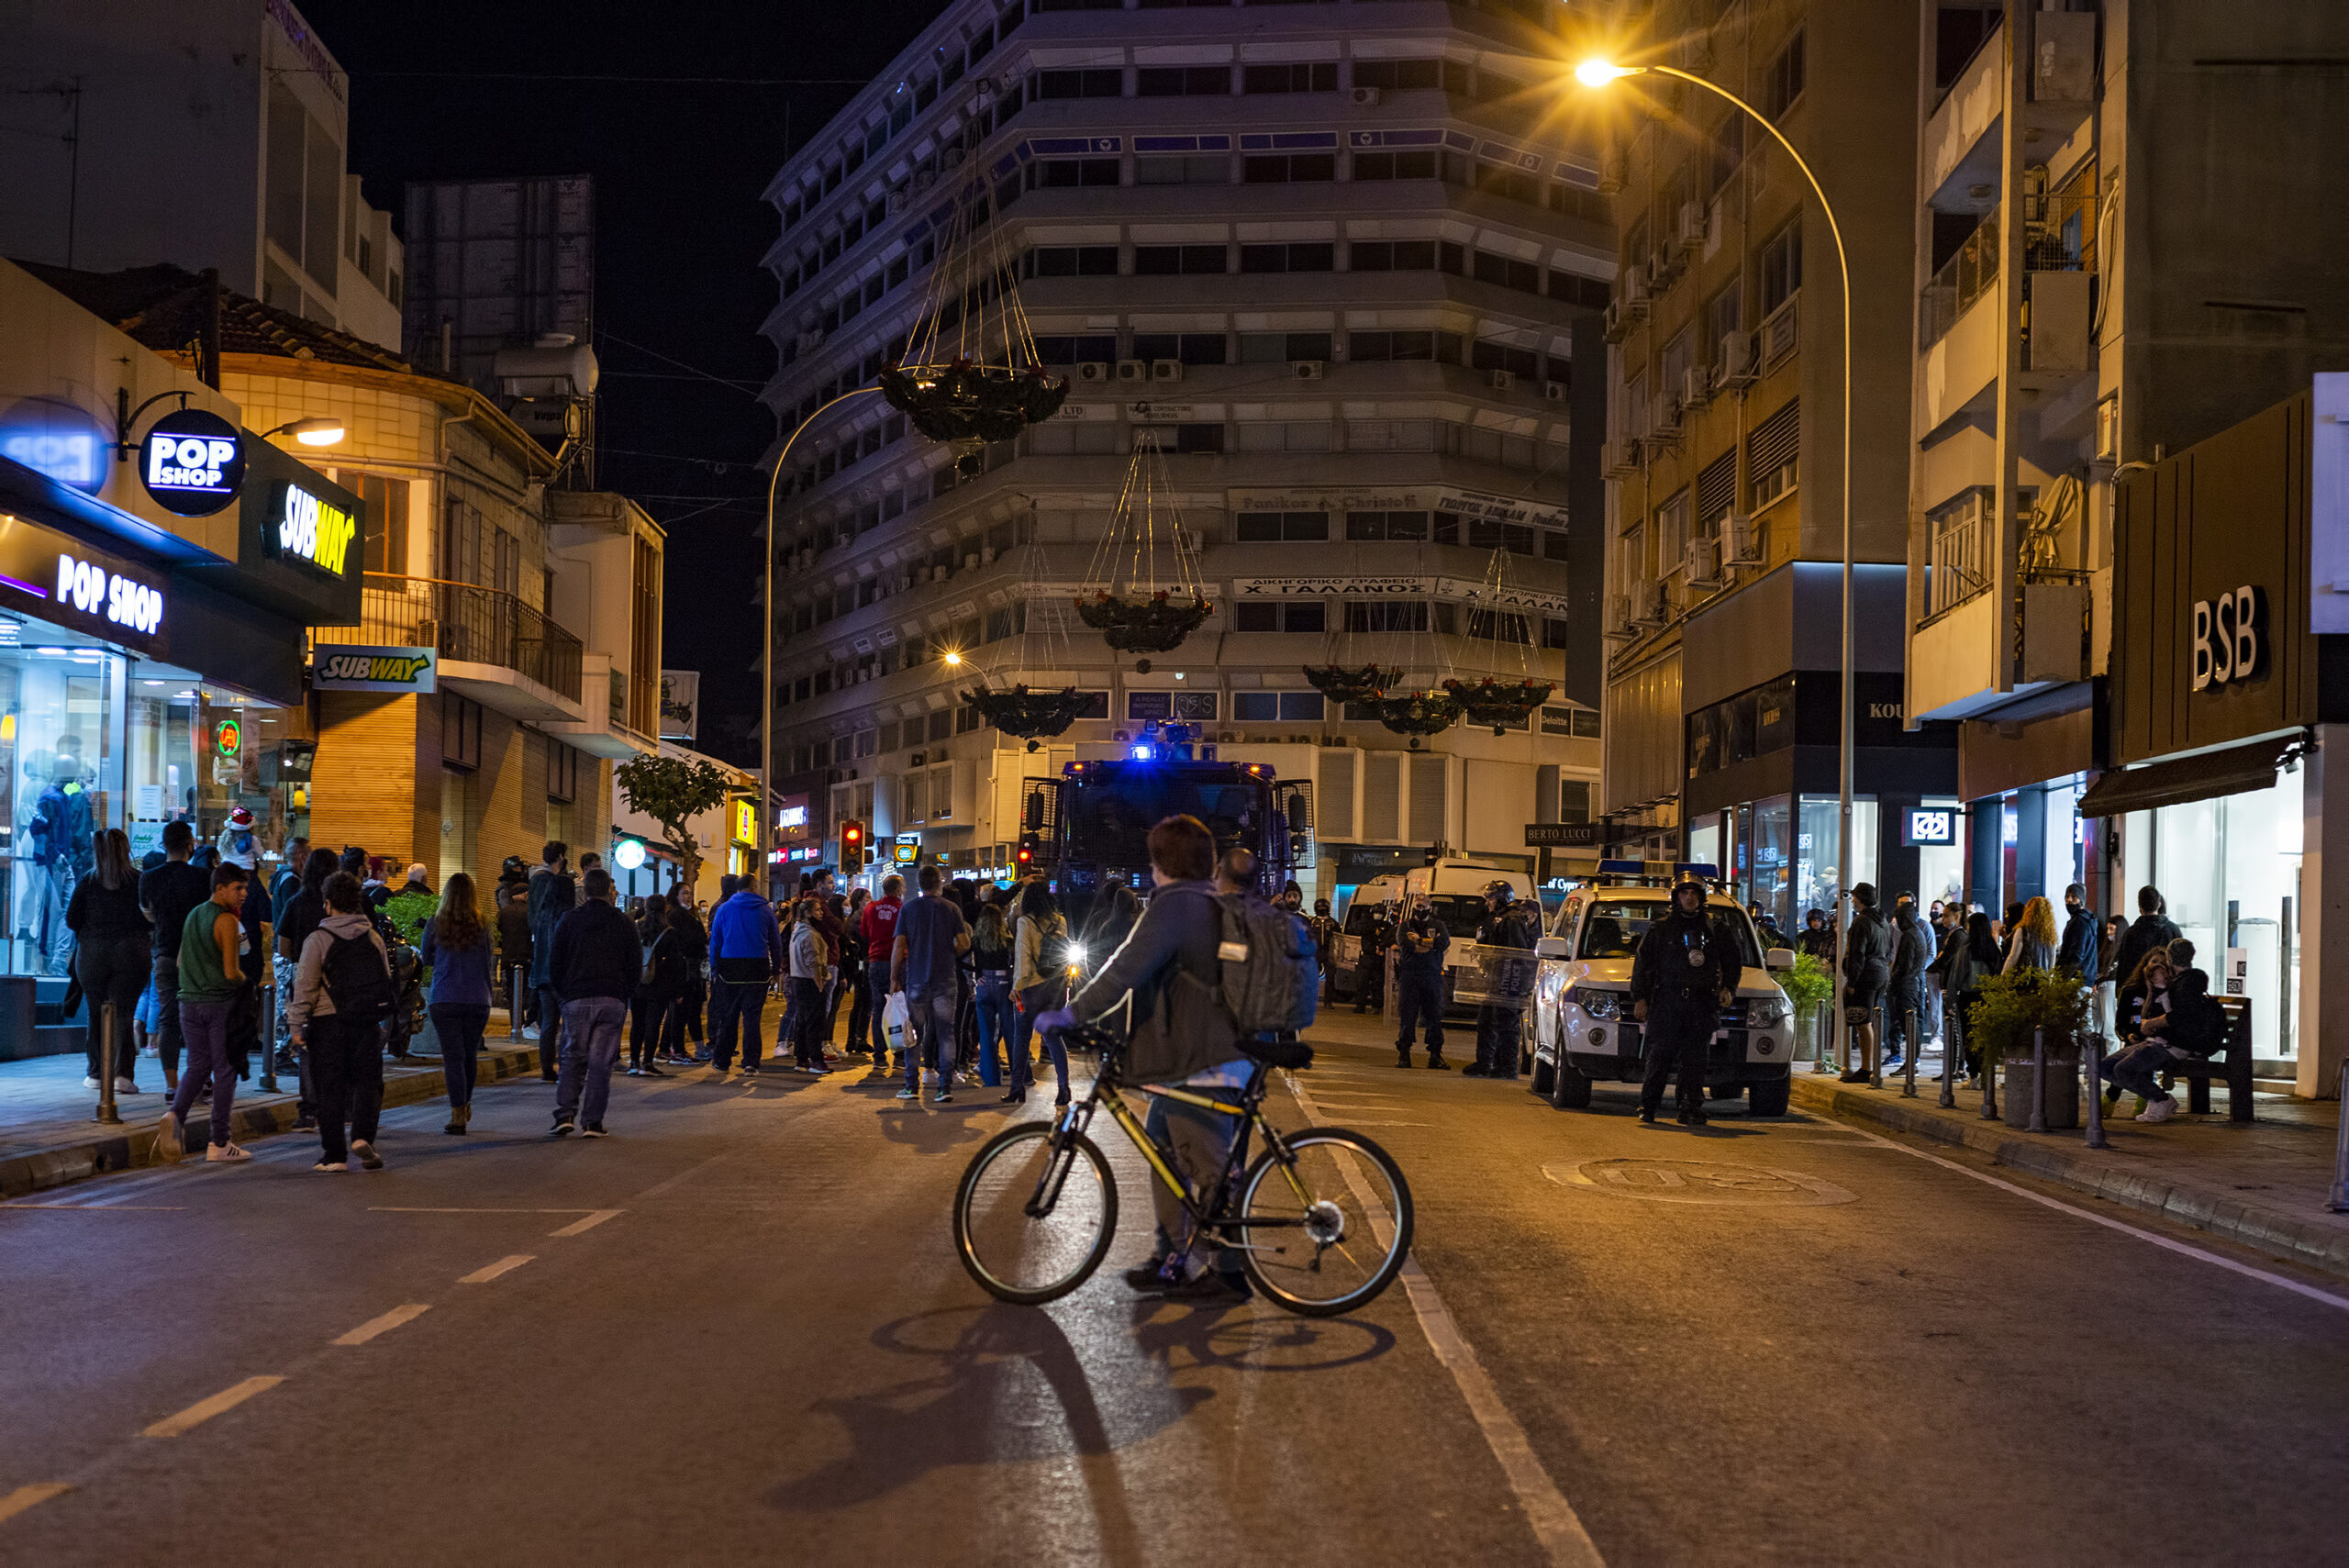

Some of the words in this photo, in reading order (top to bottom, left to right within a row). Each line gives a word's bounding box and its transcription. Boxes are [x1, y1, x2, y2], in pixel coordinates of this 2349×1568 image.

[149, 437, 235, 484] POP
[161, 466, 223, 486] SHOP
[279, 484, 356, 575] SUBWAY
[57, 553, 106, 615] POP
[107, 573, 163, 635] SHOP
[1282, 584, 1427, 594] ΓΑΛΑΝΟΣ
[2192, 584, 2257, 693] BSB
[319, 654, 430, 683] SUBWAY
[896, 837, 915, 845] Bank
[1528, 828, 1560, 840] BERTO
[1563, 828, 1591, 839] LUCCI
[1547, 877, 1557, 889] of
[1557, 877, 1585, 893] Cypr
[1510, 963, 1522, 992] POLICE
